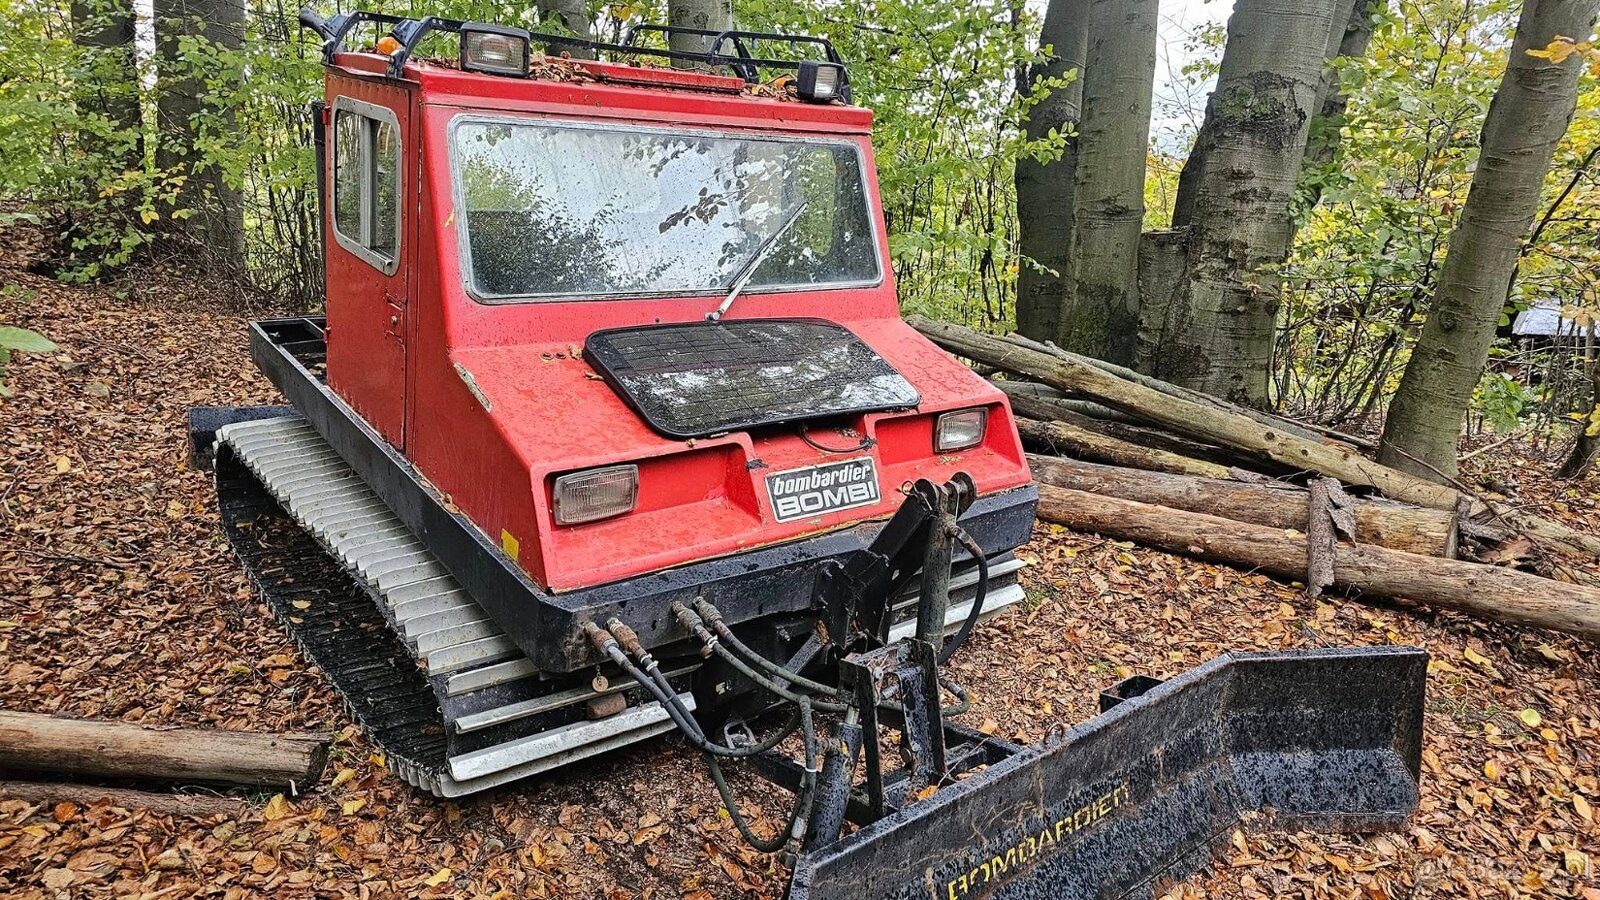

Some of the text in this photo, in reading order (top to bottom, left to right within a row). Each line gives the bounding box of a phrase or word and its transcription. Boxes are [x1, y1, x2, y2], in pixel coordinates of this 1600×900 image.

[773, 464, 871, 496] bombardier
[777, 481, 876, 517] BOMBI
[947, 783, 1130, 900] BOMBARDIER
